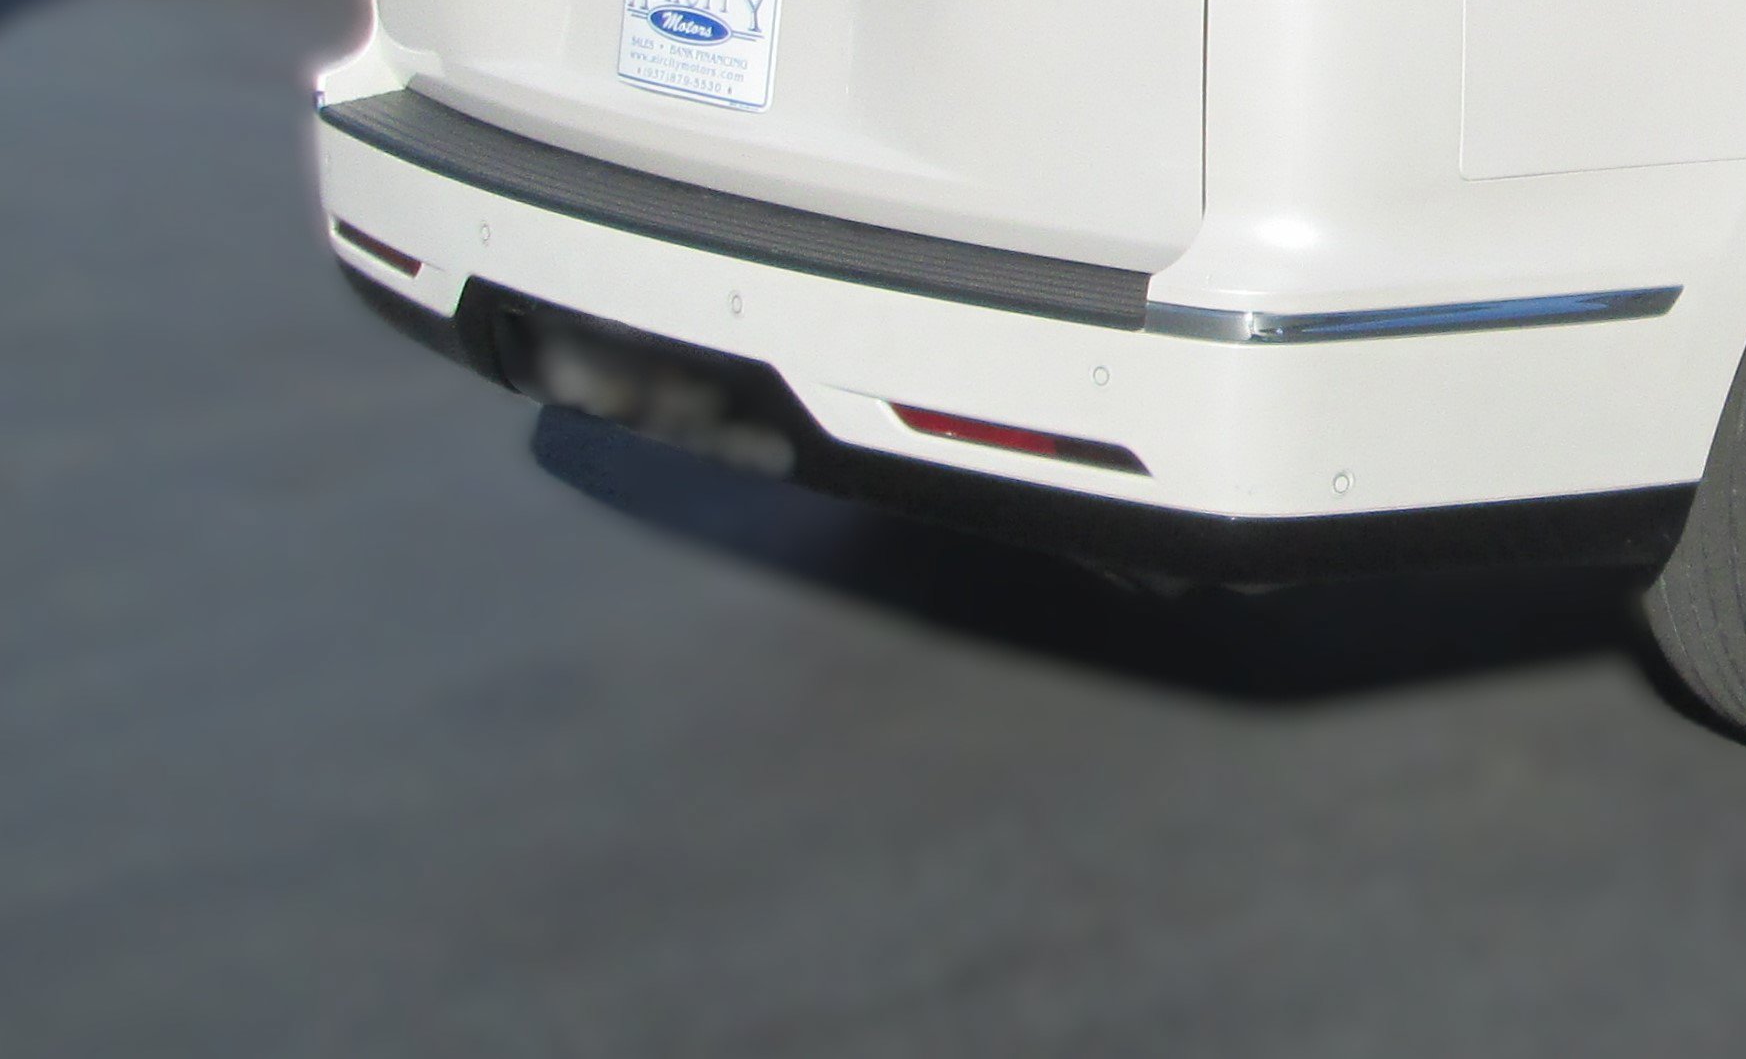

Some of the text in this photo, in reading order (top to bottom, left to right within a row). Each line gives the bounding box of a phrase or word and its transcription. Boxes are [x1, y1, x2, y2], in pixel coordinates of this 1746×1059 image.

[662, 12, 713, 38] Motors
[629, 50, 744, 83] www.aircitymotors.com
[631, 36, 748, 70] SALES BANK FINANCING
